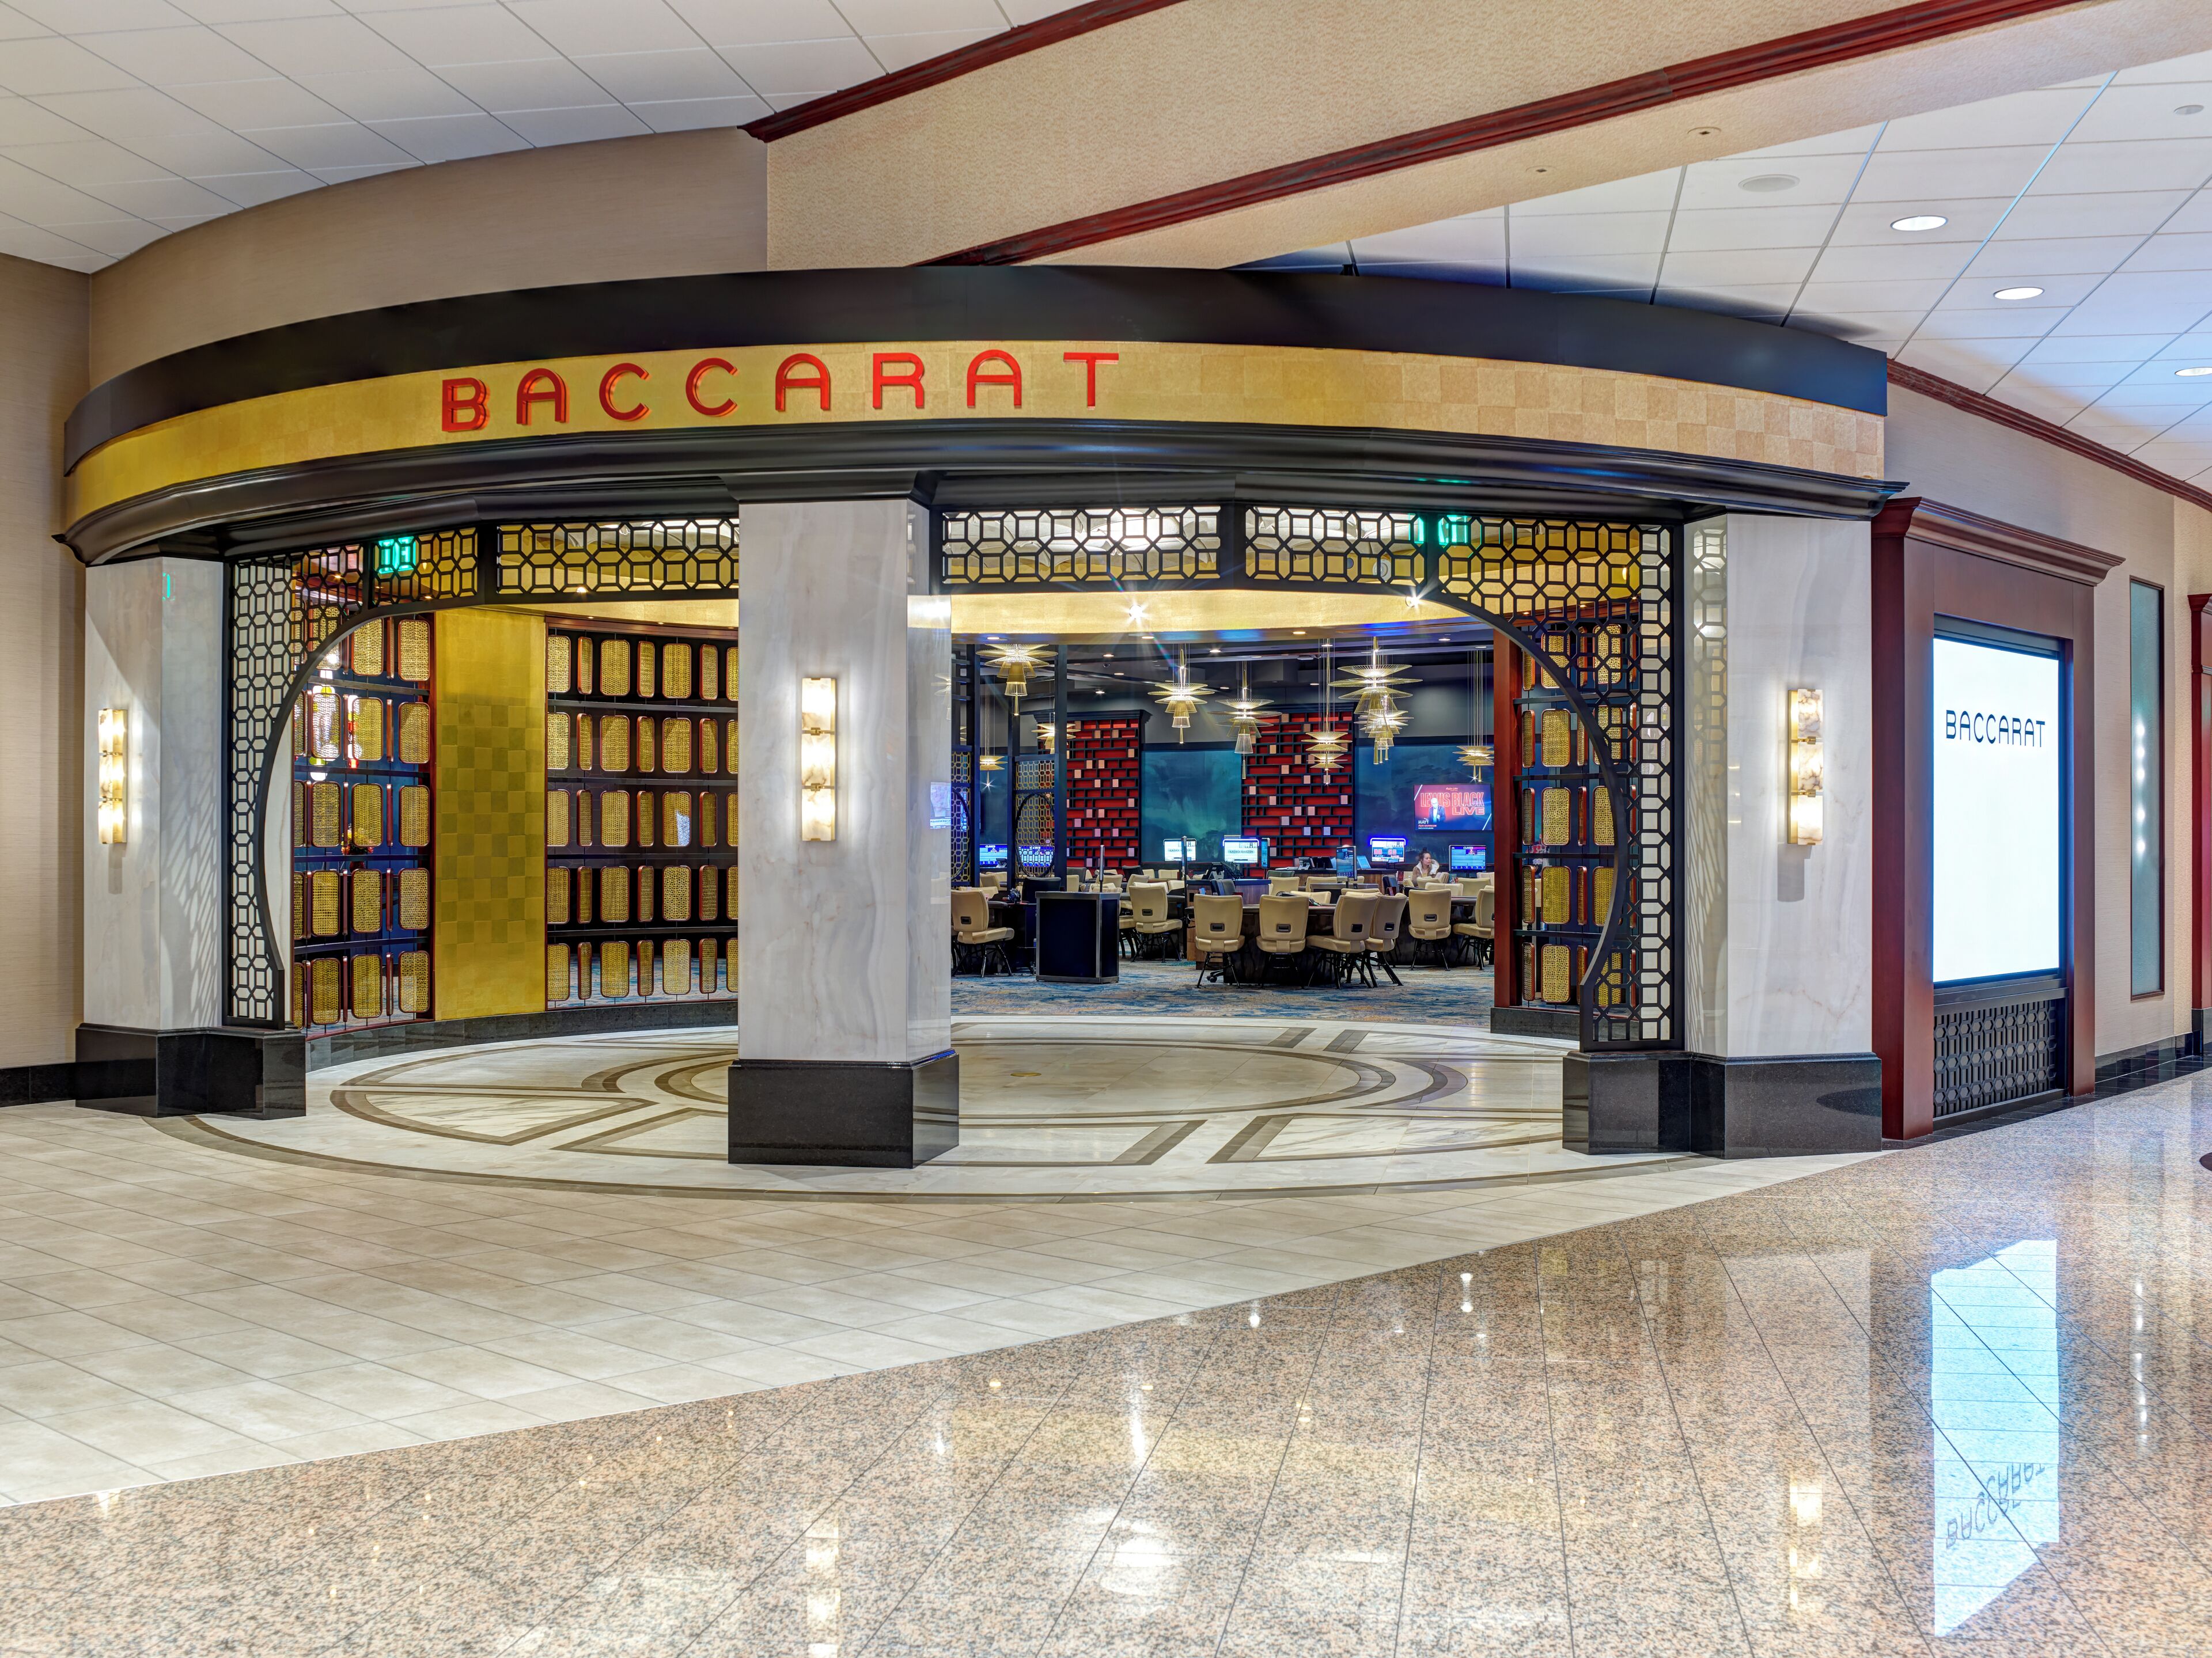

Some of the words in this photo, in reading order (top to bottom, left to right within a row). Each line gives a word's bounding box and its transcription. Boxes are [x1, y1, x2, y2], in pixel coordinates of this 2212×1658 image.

[442, 348, 1119, 432] BACCARAT
[1946, 710, 2046, 748] BACCARAT
[1420, 792, 1450, 807] LEWIS
[1451, 792, 1484, 807] BLACK
[1452, 807, 1485, 815] LIVE
